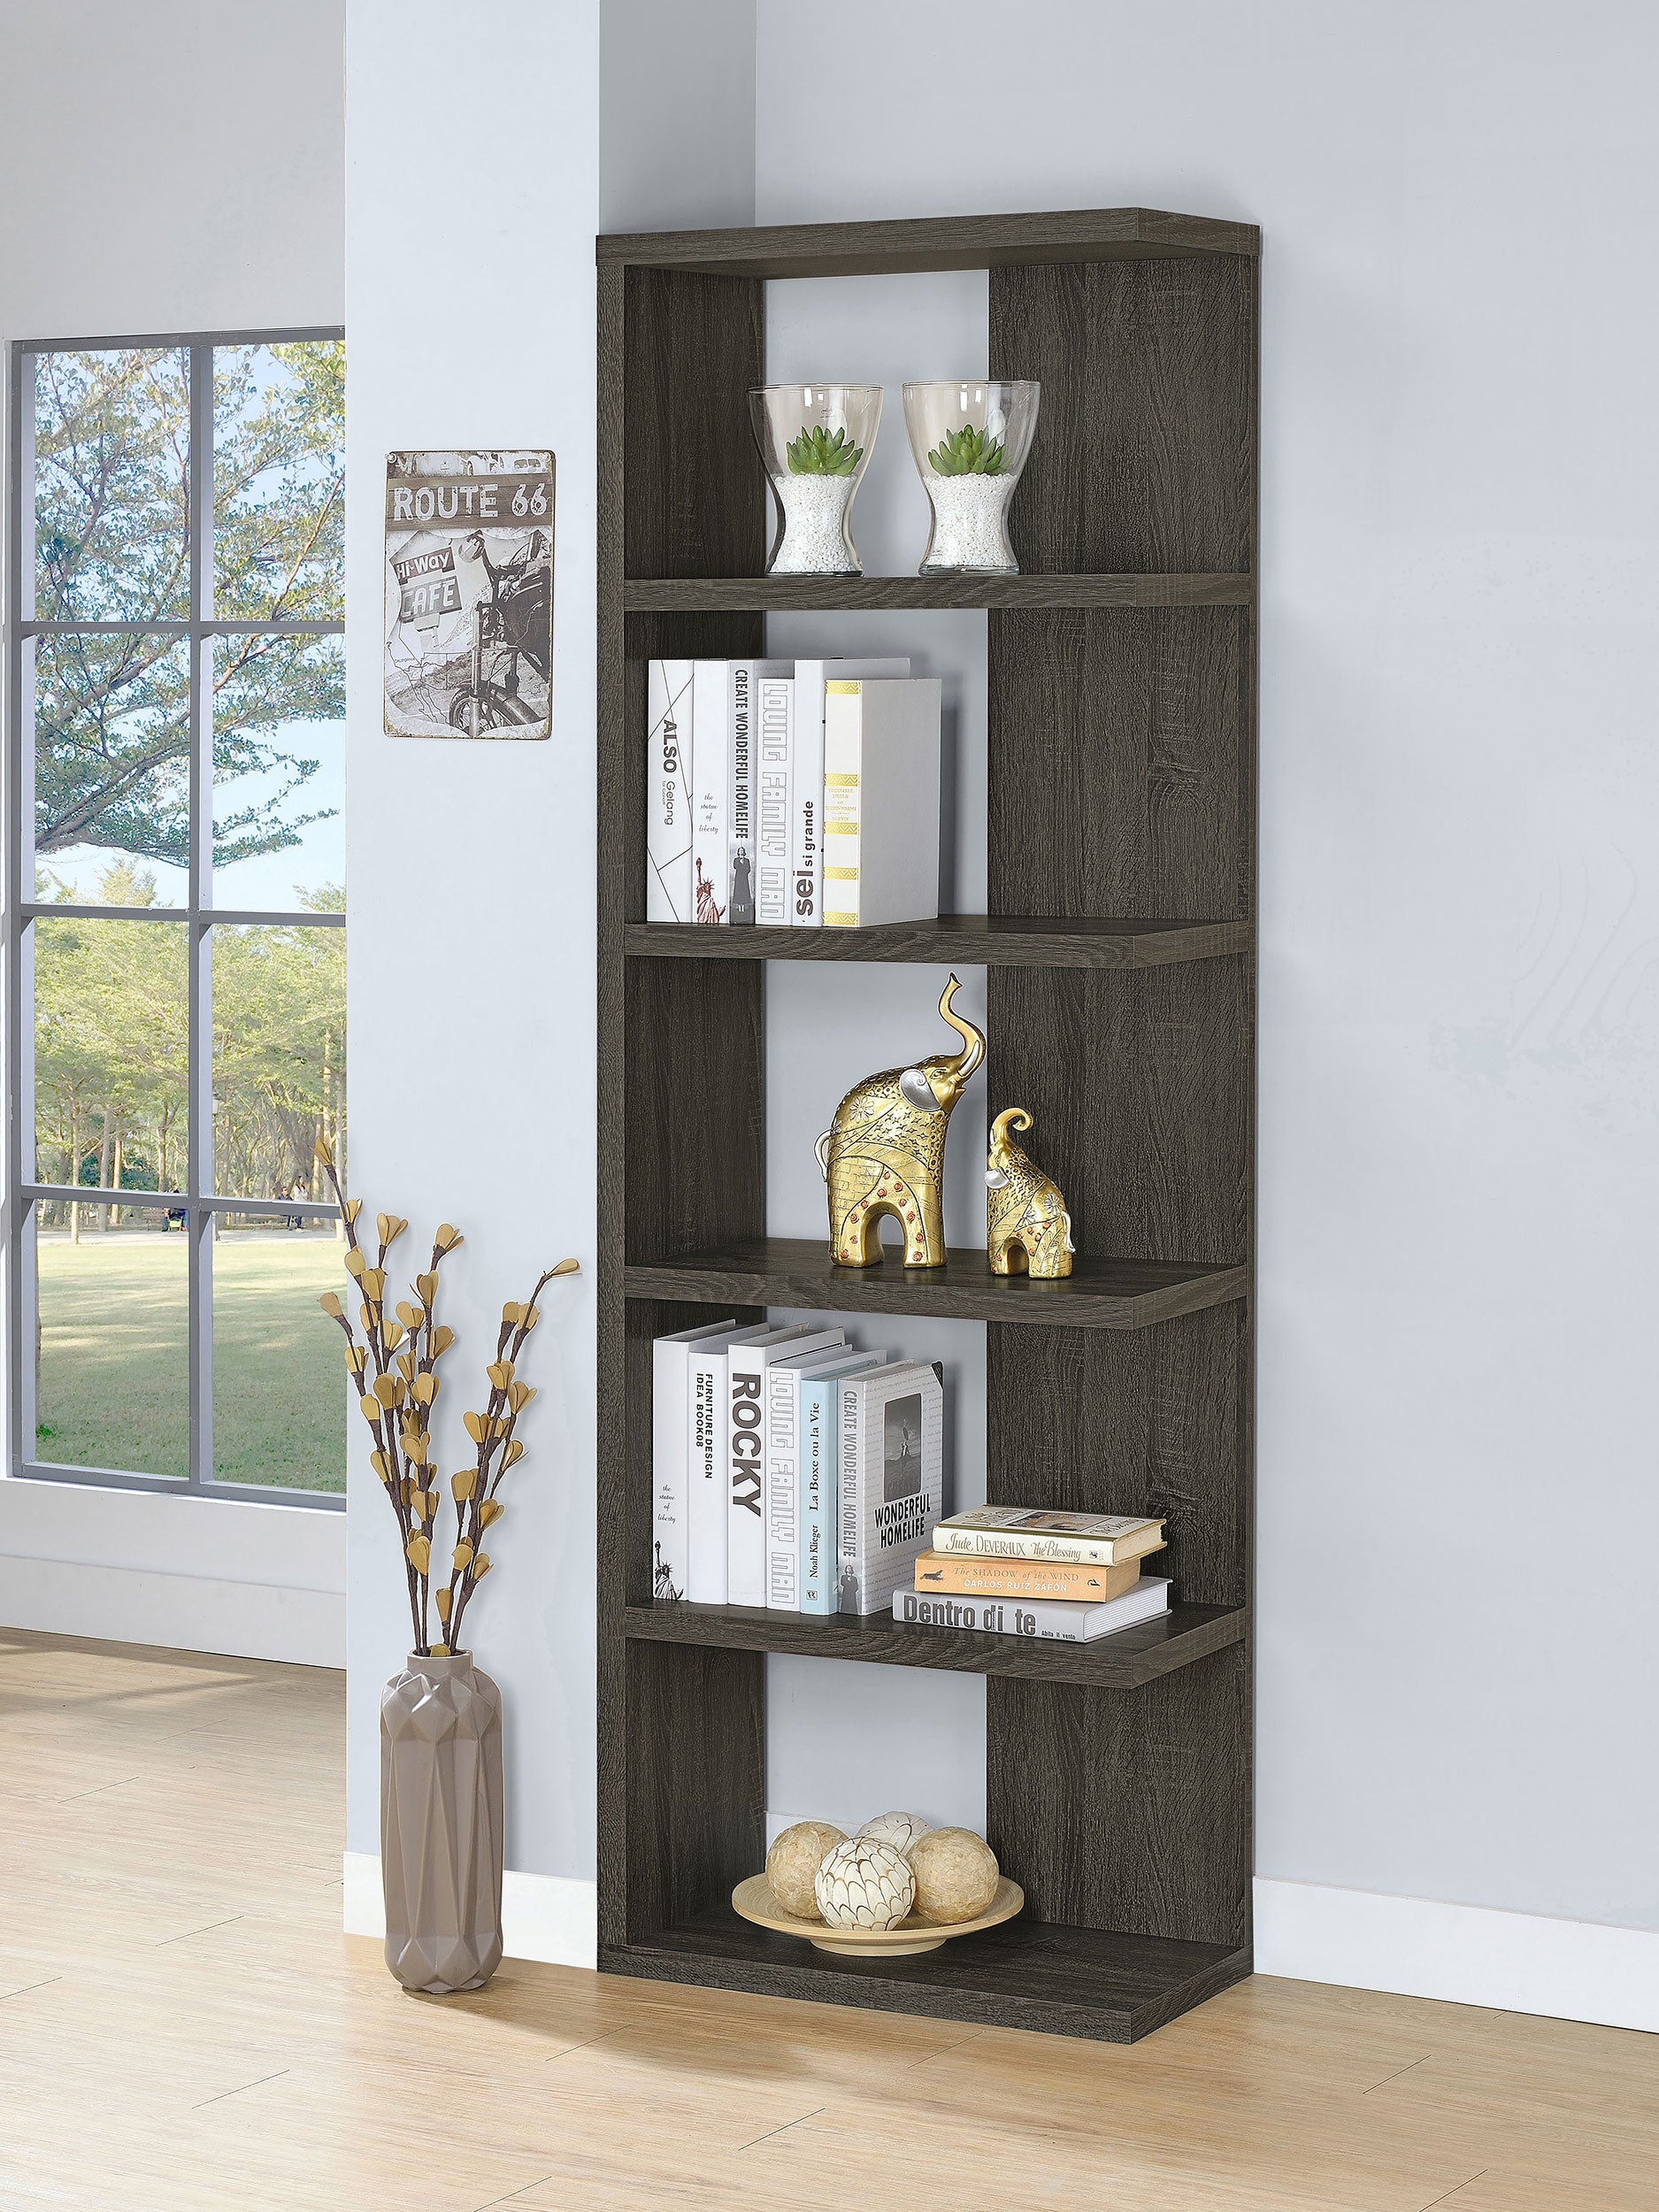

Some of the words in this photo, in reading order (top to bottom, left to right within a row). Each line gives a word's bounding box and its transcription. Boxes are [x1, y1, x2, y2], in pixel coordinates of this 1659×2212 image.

[394, 483, 498, 521] ROUTE
[511, 482, 548, 517] 66
[396, 551, 449, 580] Hi-Way
[401, 578, 456, 618] CAFE
[735, 669, 749, 709] CREATE
[763, 684, 788, 761] LOVING
[664, 719, 677, 773] ALSO
[735, 712, 749, 781] WONDERFUL
[664, 780, 676, 826] Gelang
[705, 812, 713, 821] of
[735, 785, 749, 839] HOMELIFE
[762, 772, 787, 856] FAMILY
[698, 824, 719, 834] liberty
[803, 800, 816, 850] grande
[803, 852, 813, 867] si
[760, 867, 786, 918] MAN
[793, 871, 814, 917] sei
[695, 1373, 704, 1398] IDEA
[695, 1403, 704, 1448] BOOK08
[770, 1371, 795, 1448] LOVING
[810, 1402, 819, 1423] Vie
[843, 1390, 857, 1430] CREATE
[732, 1372, 762, 1517] ROCKY
[810, 1426, 819, 1438] la
[811, 1441, 819, 1456] ou
[809, 1460, 818, 1491] Boxe
[843, 1433, 857, 1500] WONDERFUL
[771, 1458, 795, 1543] FAMILY
[809, 1494, 818, 1511] La
[874, 1493, 931, 1529] WONDERFUL
[809, 1524, 821, 1553] Klieger
[843, 1503, 857, 1557] HOMELIFE
[880, 1516, 925, 1548] HOMELIFE
[946, 1532, 973, 1551] Jude
[976, 1535, 1025, 1556] DEVERAUX
[1031, 1541, 1046, 1556] The
[1044, 1540, 1081, 1563] Blessing
[771, 1552, 795, 1604] MAN
[809, 1555, 818, 1578] Noah
[964, 1578, 1002, 1588] CARLOS
[1007, 1580, 1031, 1590] RUIZ
[973, 1568, 1018, 1578] SHADOW
[1022, 1571, 1032, 1580] of
[1050, 1571, 1079, 1581] WIND
[903, 1594, 976, 1629] Dentro
[983, 1604, 1003, 1632] di
[1014, 1608, 1036, 1636] te
